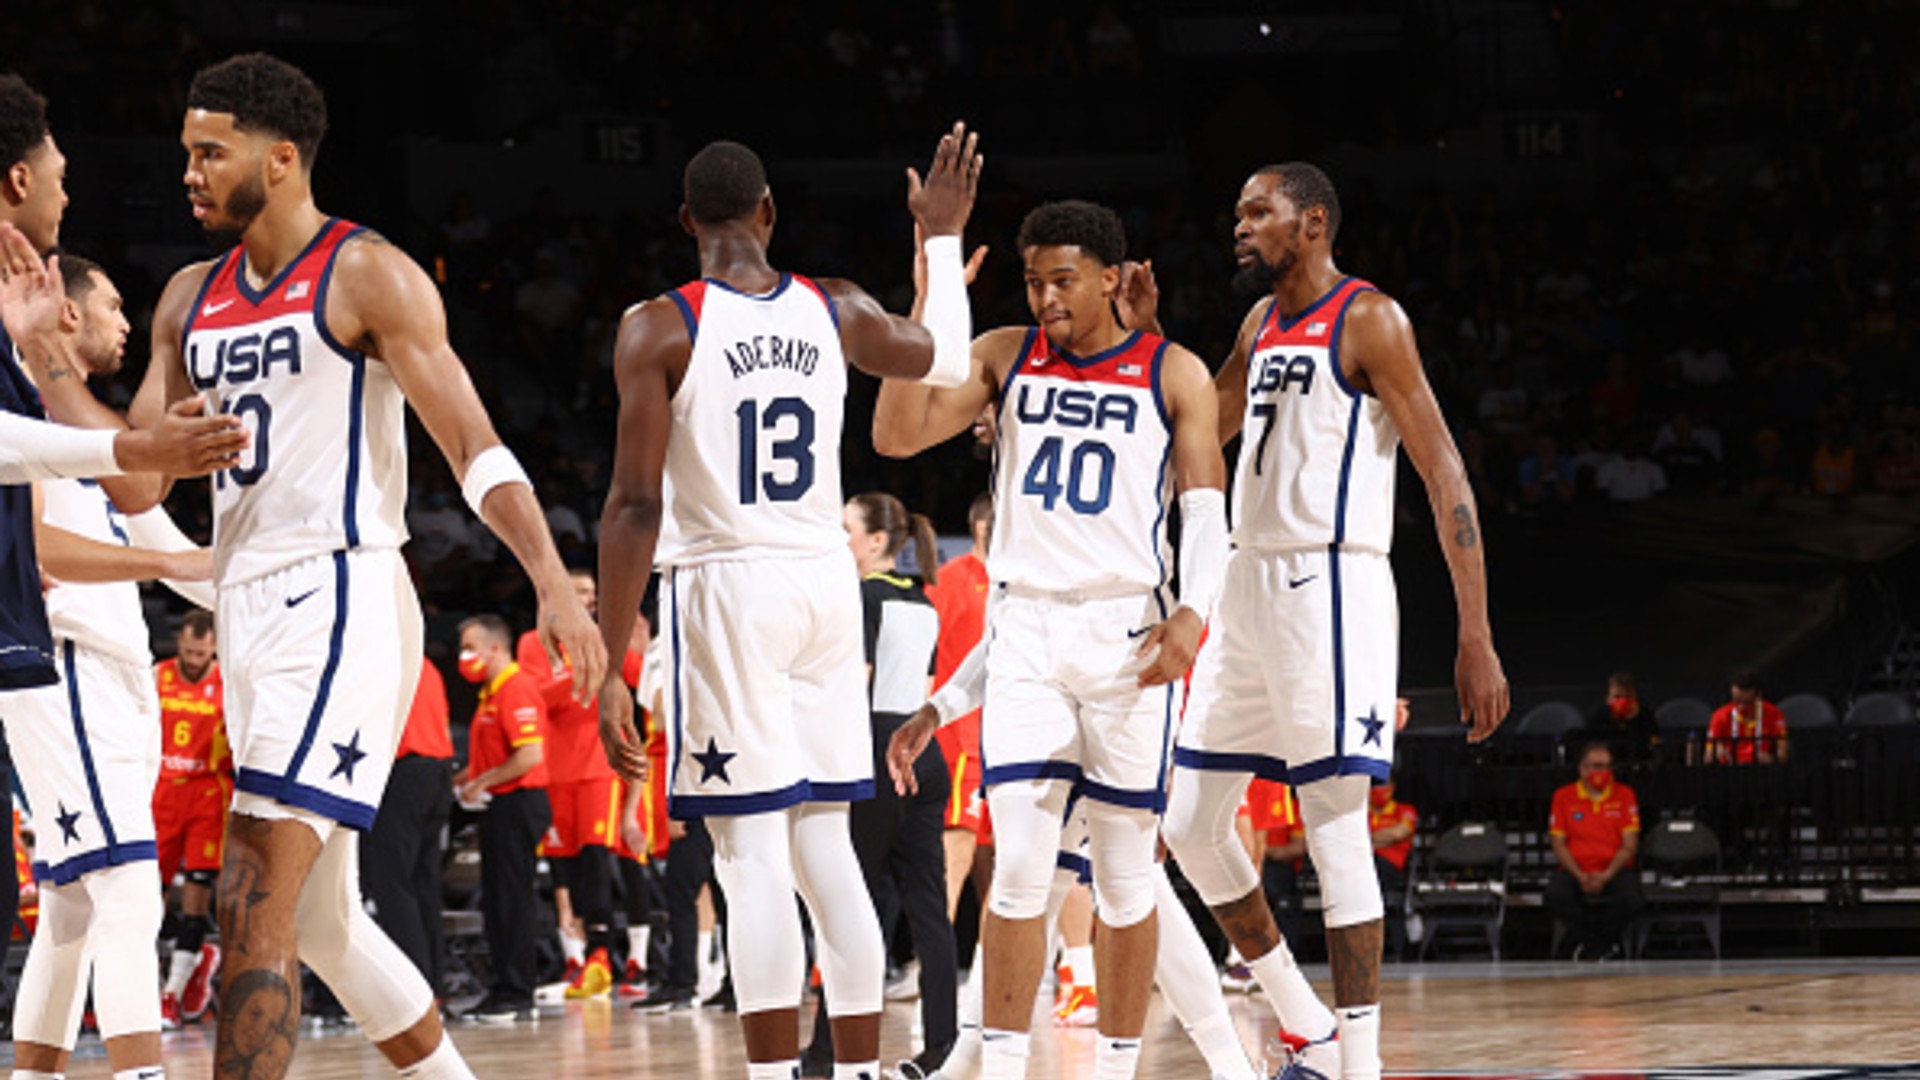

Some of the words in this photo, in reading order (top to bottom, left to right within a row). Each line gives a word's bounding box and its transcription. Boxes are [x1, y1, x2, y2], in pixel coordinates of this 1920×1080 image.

[597, 126, 643, 162] 115
[1516, 120, 1563, 156] 114
[190, 326, 301, 390] USA
[723, 335, 819, 379] ADEBAYO
[1017, 384, 1138, 433] USA
[735, 396, 816, 505] 13
[1251, 403, 1277, 476] 7
[1022, 436, 1116, 515] 40
[173, 720, 191, 747] 6
